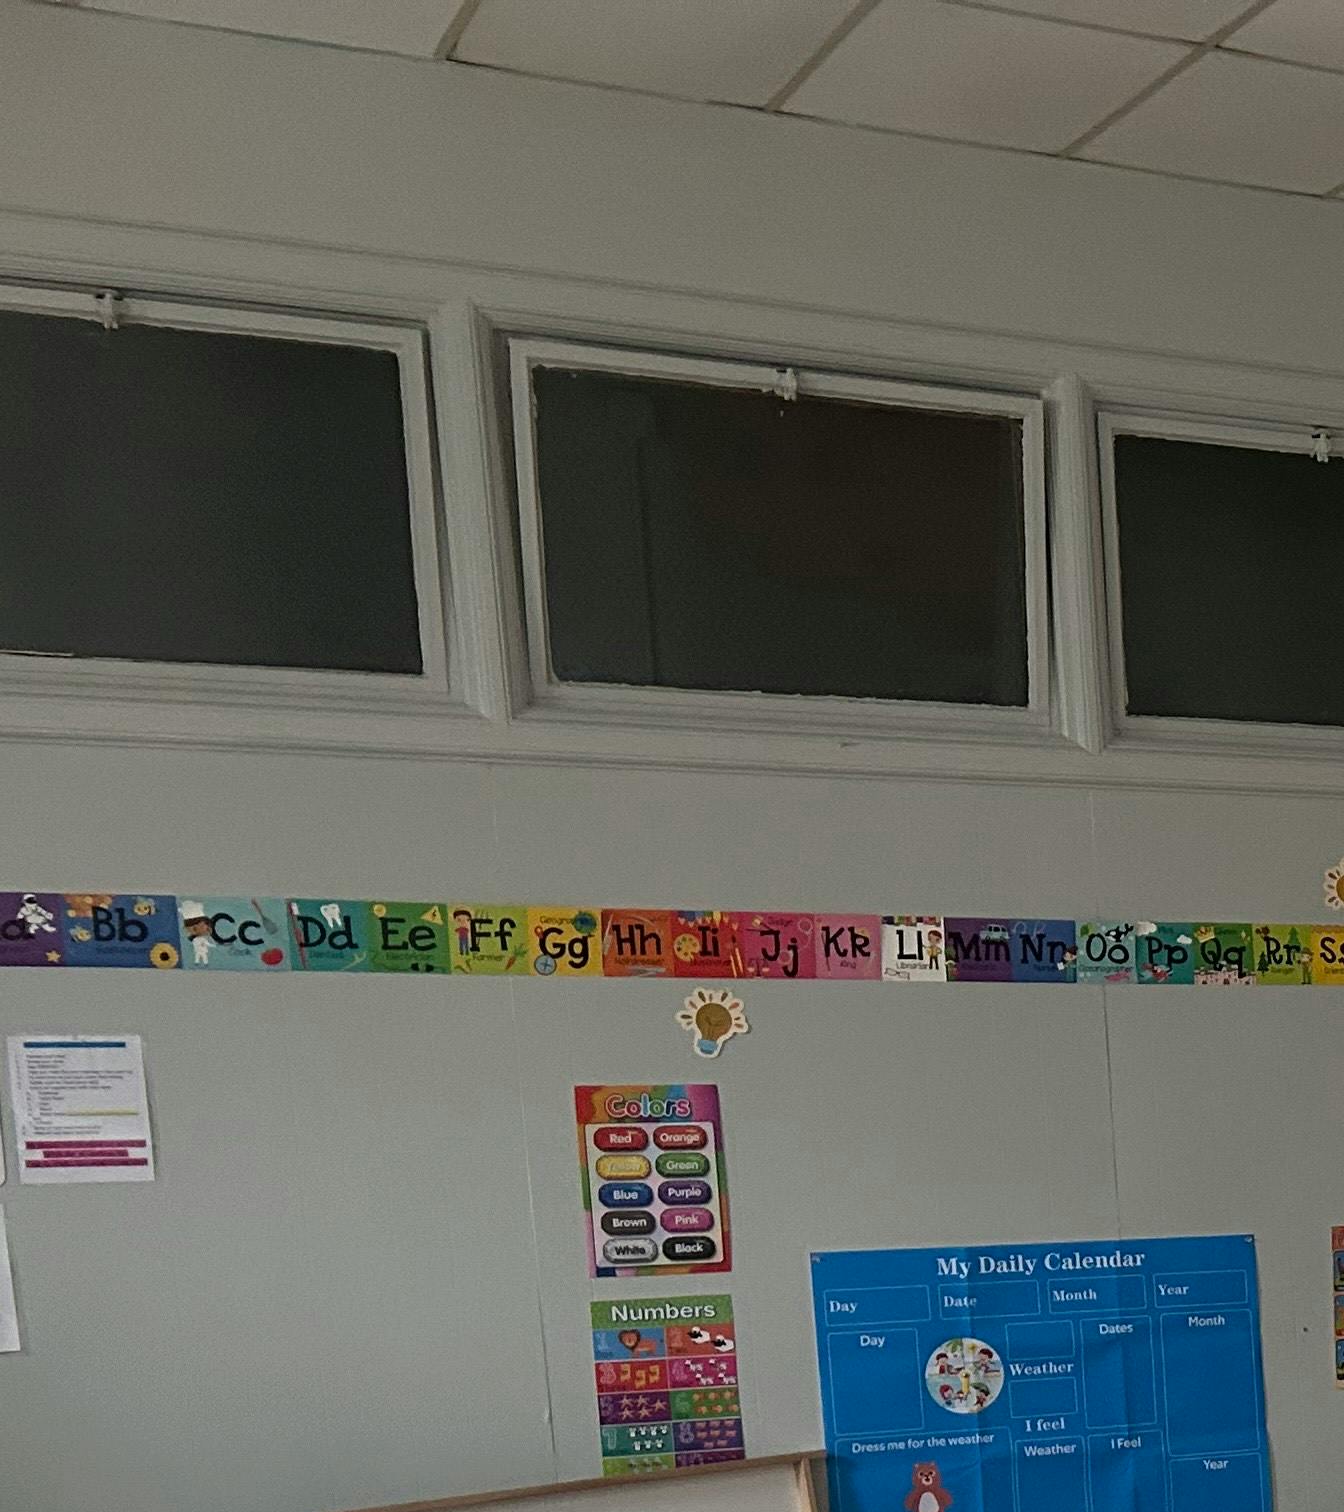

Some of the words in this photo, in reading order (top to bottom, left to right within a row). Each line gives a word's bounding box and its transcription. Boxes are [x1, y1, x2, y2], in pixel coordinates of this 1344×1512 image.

[92, 905, 150, 943] Bb
[210, 912, 265, 946] Cc
[297, 915, 360, 950] Dd
[379, 916, 438, 951] Ee
[470, 917, 517, 952] Ff
[538, 927, 596, 970] Gg
[612, 923, 663, 956] Hh
[698, 926, 720, 957] Ii
[758, 929, 799, 977] Jj
[821, 926, 871, 958] Kk
[896, 929, 923, 960] Ll
[948, 931, 1011, 962] Mm
[1085, 933, 1130, 965] Oo
[1145, 936, 1189, 976] Pp
[1200, 937, 1246, 979] Qq
[1265, 935, 1300, 965] Rr
[605, 1093, 692, 1118] Colors
[609, 1133, 633, 1144] Red
[660, 1133, 700, 1145] Orange
[666, 1161, 699, 1171] Green
[613, 1190, 638, 1200] Blue
[668, 1188, 702, 1199] Purple
[612, 1218, 647, 1228] Brown
[675, 1215, 699, 1225] Pink
[614, 1245, 646, 1256] White
[675, 1244, 703, 1253] Black
[938, 1256, 970, 1279] My
[979, 1254, 1036, 1275] Daily
[1044, 1250, 1145, 1271] Calendar
[1053, 1289, 1097, 1301] Month
[1158, 1284, 1189, 1295] Year
[829, 1300, 858, 1314] Day
[944, 1295, 976, 1308] Date
[611, 1304, 716, 1322] Numbers
[1188, 1315, 1225, 1327] Month
[1099, 1322, 1134, 1334] Dates
[860, 1335, 885, 1348] Day
[1009, 1362, 1074, 1376] Weather
[1025, 1419, 1031, 1432] I
[1034, 1417, 1066, 1431] feel
[852, 1440, 886, 1453] Dress
[887, 1440, 906, 1450] me
[907, 1437, 925, 1449] for
[927, 1435, 946, 1447] the
[948, 1432, 995, 1446] weather
[1117, 1437, 1142, 1449] Feel
[1024, 1443, 1077, 1457] Weather
[1202, 1458, 1229, 1470] Year
